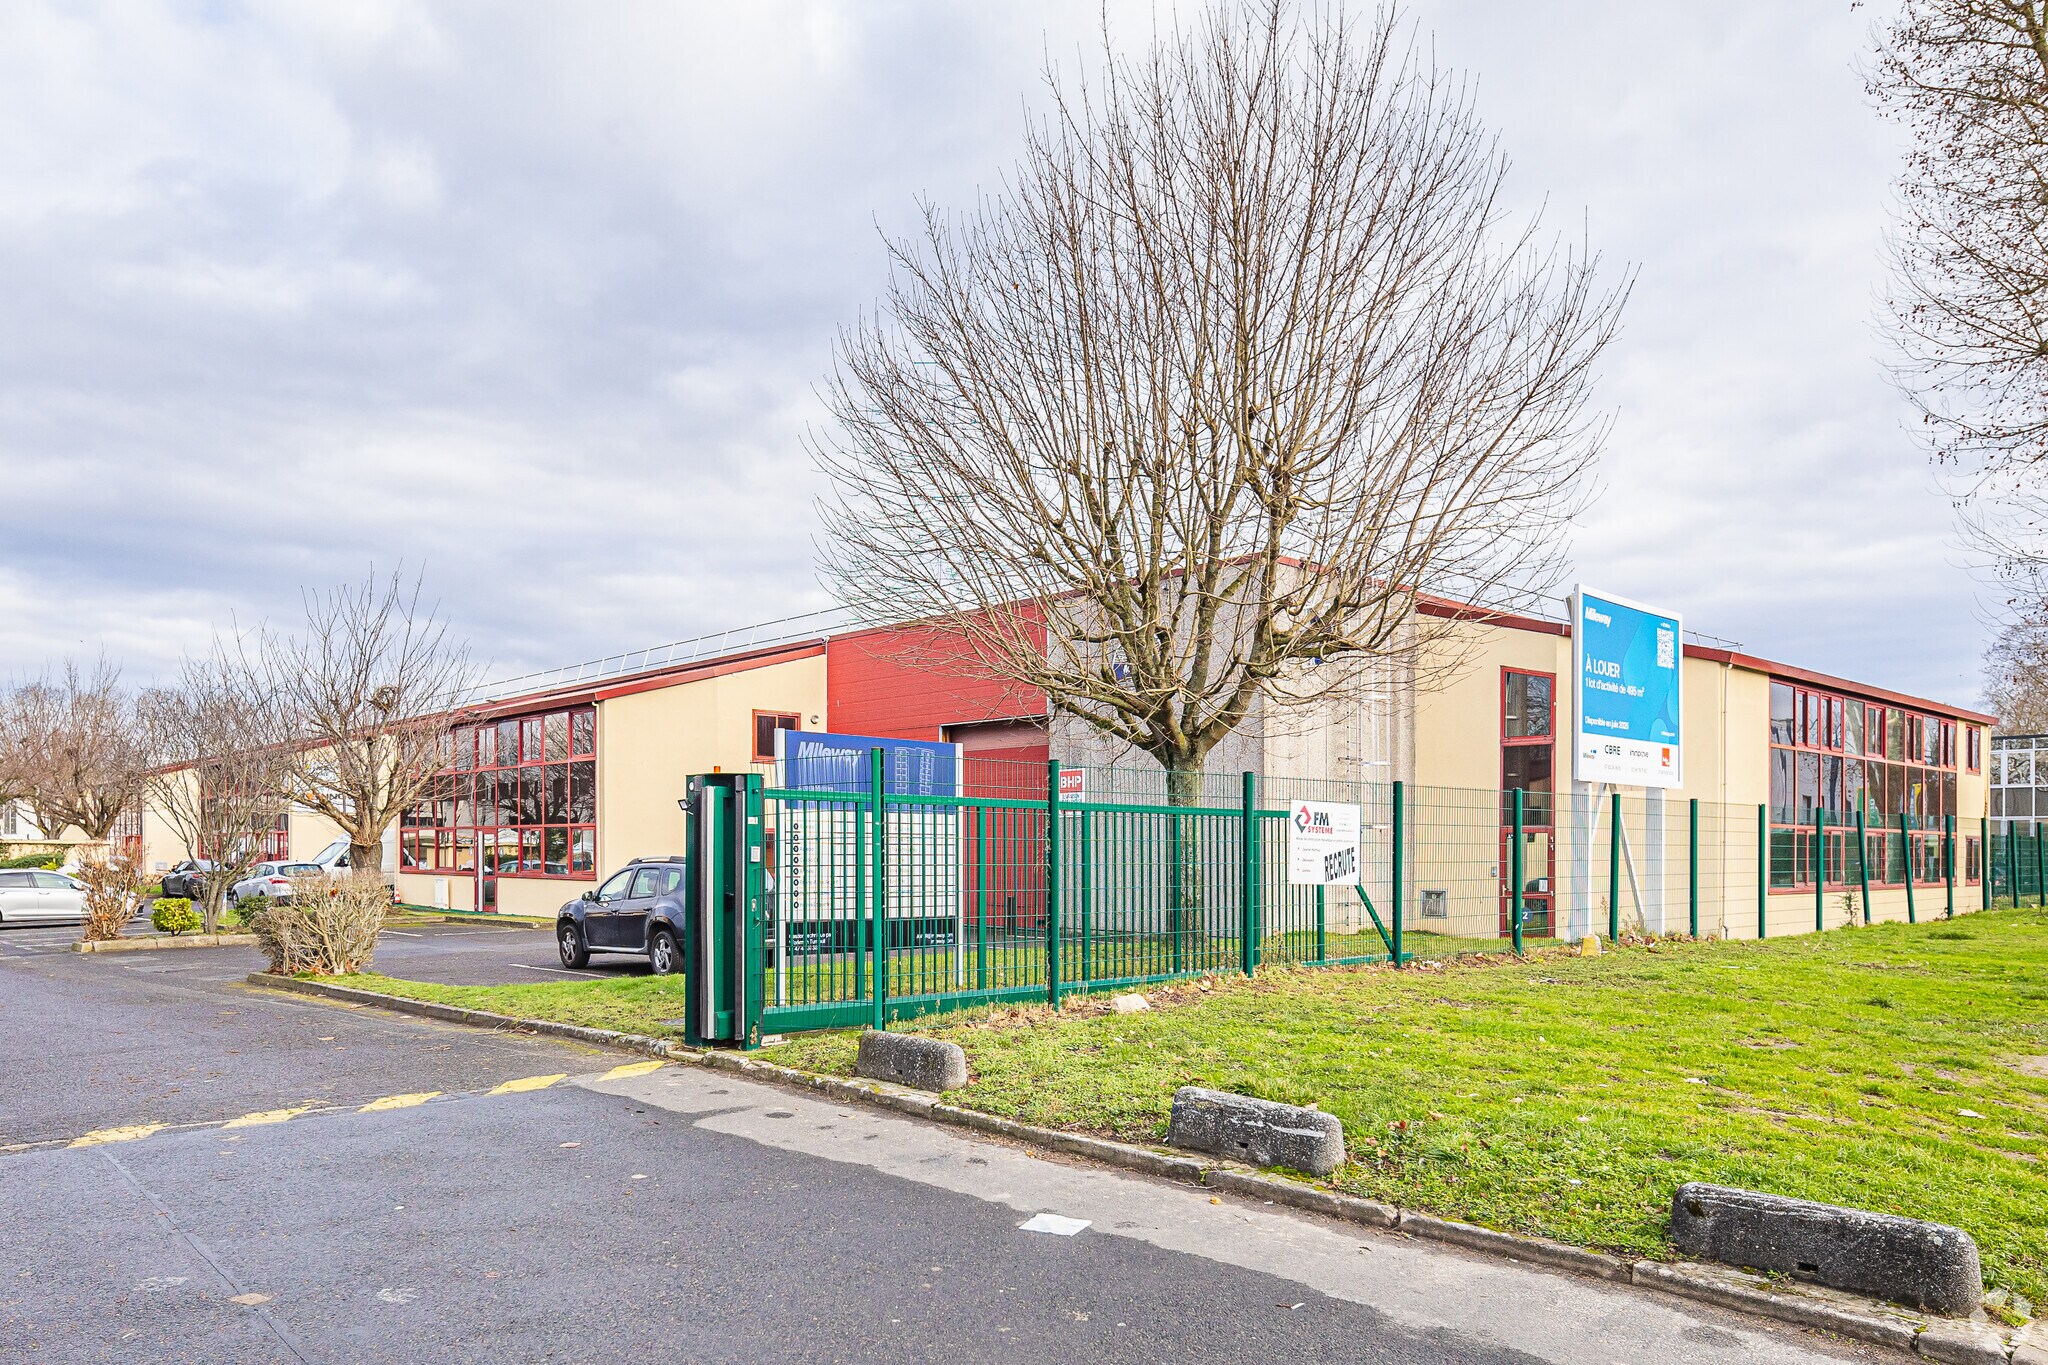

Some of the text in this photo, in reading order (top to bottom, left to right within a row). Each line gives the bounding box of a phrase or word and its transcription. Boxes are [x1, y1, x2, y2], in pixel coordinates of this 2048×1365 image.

[1585, 606, 1611, 628] Mileway
[1585, 653, 1620, 678] À LOUER
[1619, 684, 1626, 694] de
[797, 741, 863, 767] Mileway
[1604, 745, 1621, 756] CBRE
[1060, 776, 1081, 788] BHP
[1313, 812, 1330, 826] FM
[1307, 826, 1333, 834] SYSTEME
[1324, 847, 1356, 882] RECRUTE
